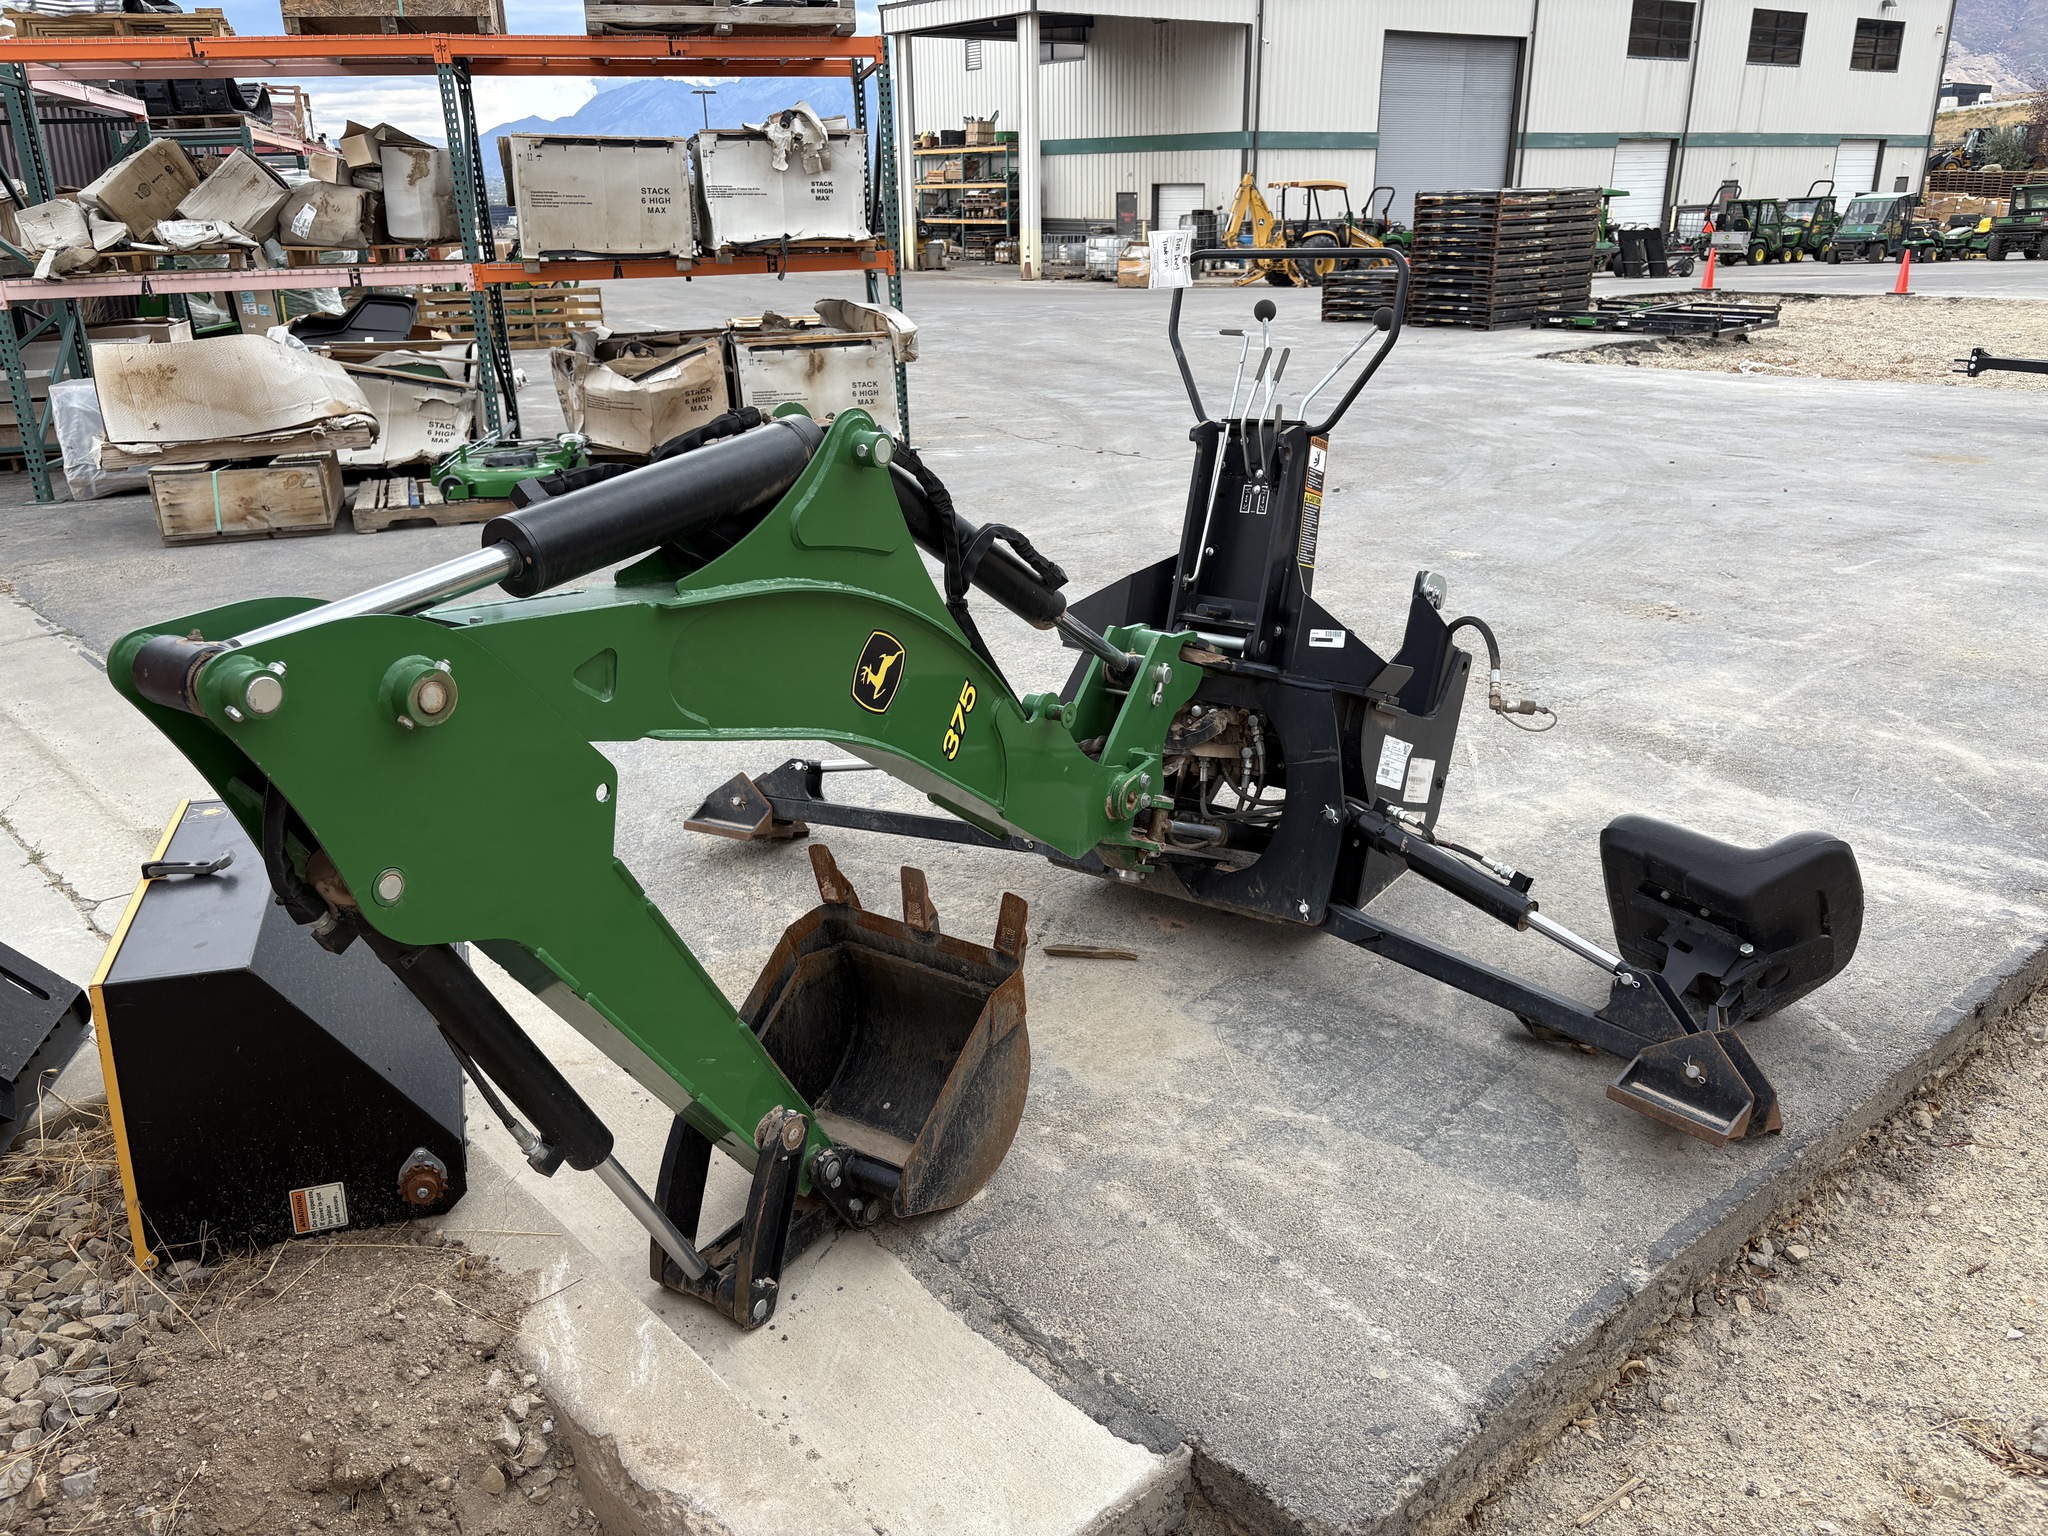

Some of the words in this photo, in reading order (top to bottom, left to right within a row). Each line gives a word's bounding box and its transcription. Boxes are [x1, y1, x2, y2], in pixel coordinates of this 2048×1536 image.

[641, 187, 670, 195] STACK
[641, 197, 646, 205] 6
[649, 197, 671, 205] HIGH
[851, 381, 878, 389] STACK
[685, 387, 712, 397] STACK
[692, 395, 713, 404] HIGH
[690, 404, 709, 412] MAX
[1309, 495, 1321, 505] CAUTION
[942, 677, 978, 761] 375
[296, 1195, 305, 1223] WARNING
